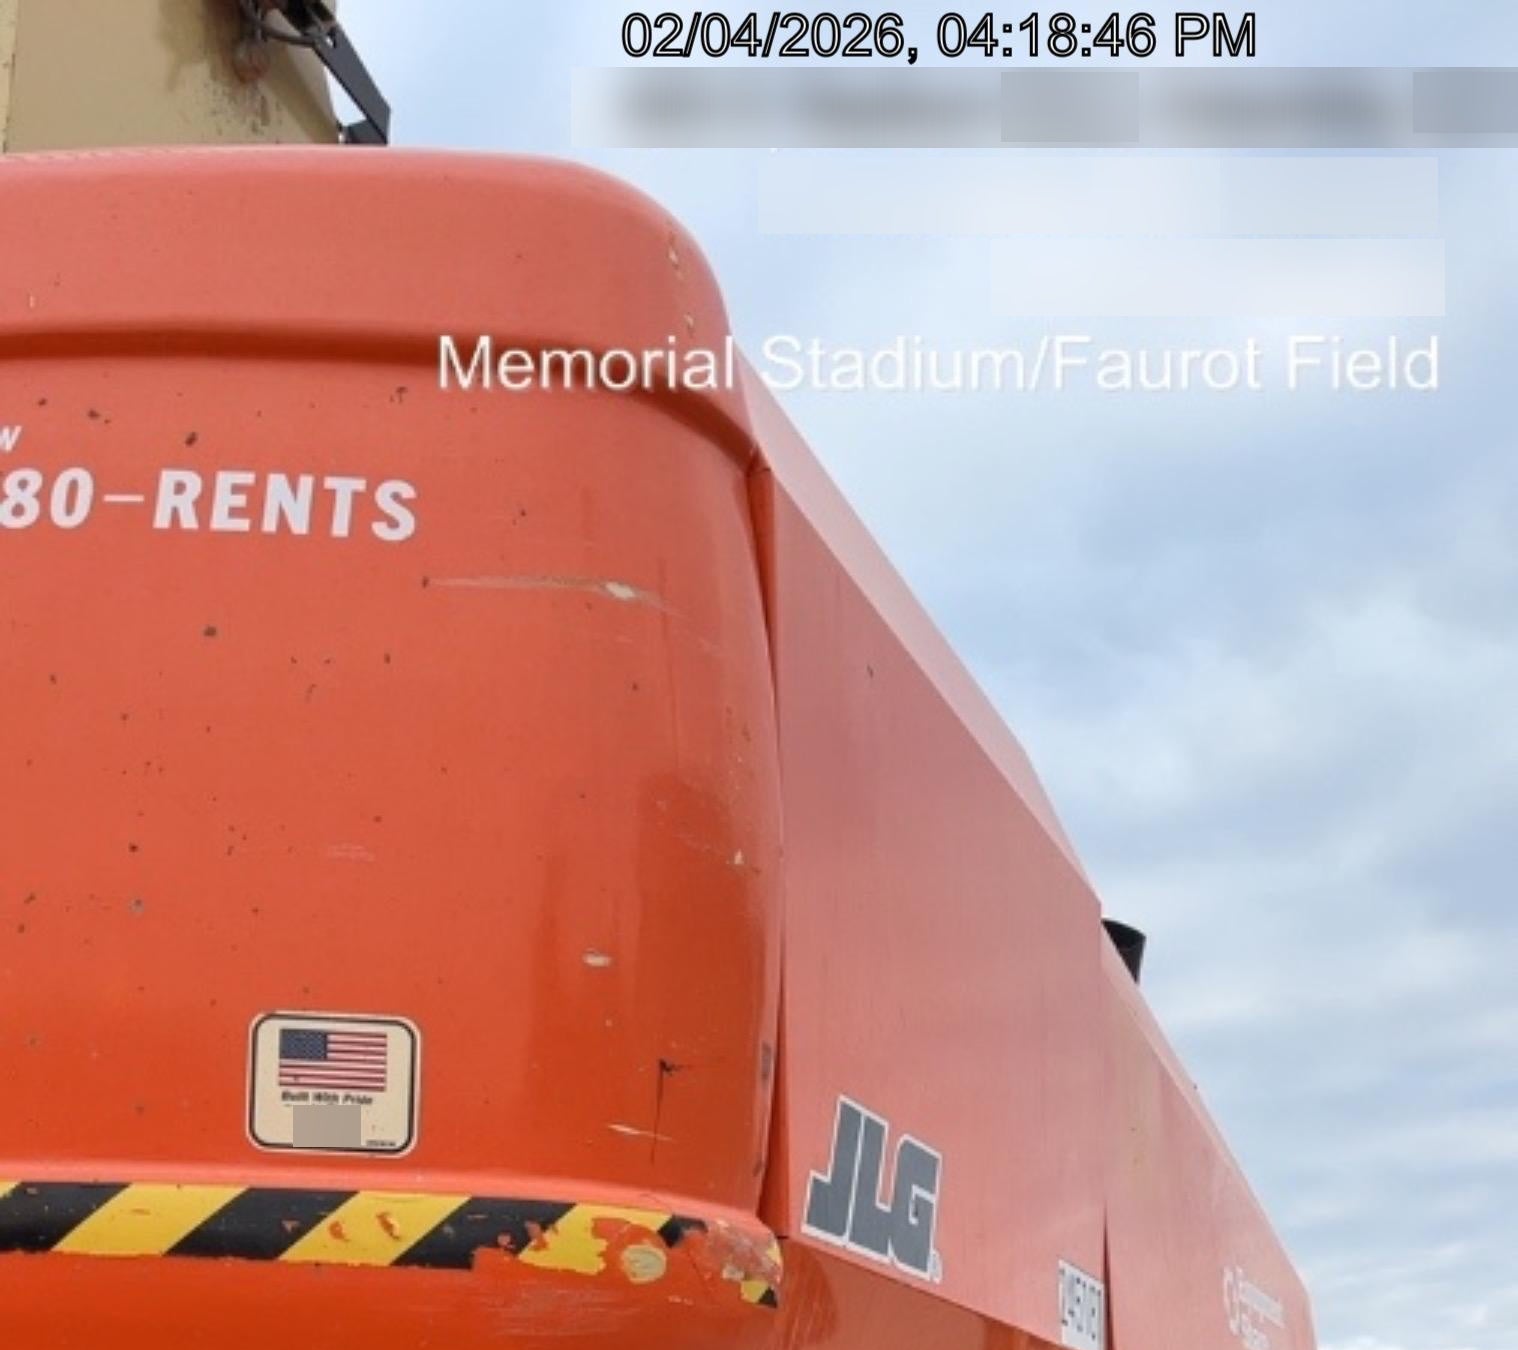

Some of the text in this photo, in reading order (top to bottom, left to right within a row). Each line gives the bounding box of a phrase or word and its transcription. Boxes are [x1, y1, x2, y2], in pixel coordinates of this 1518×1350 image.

[281, 1090, 373, 1105] Built With Pride
[801, 1094, 943, 1282] JLG
